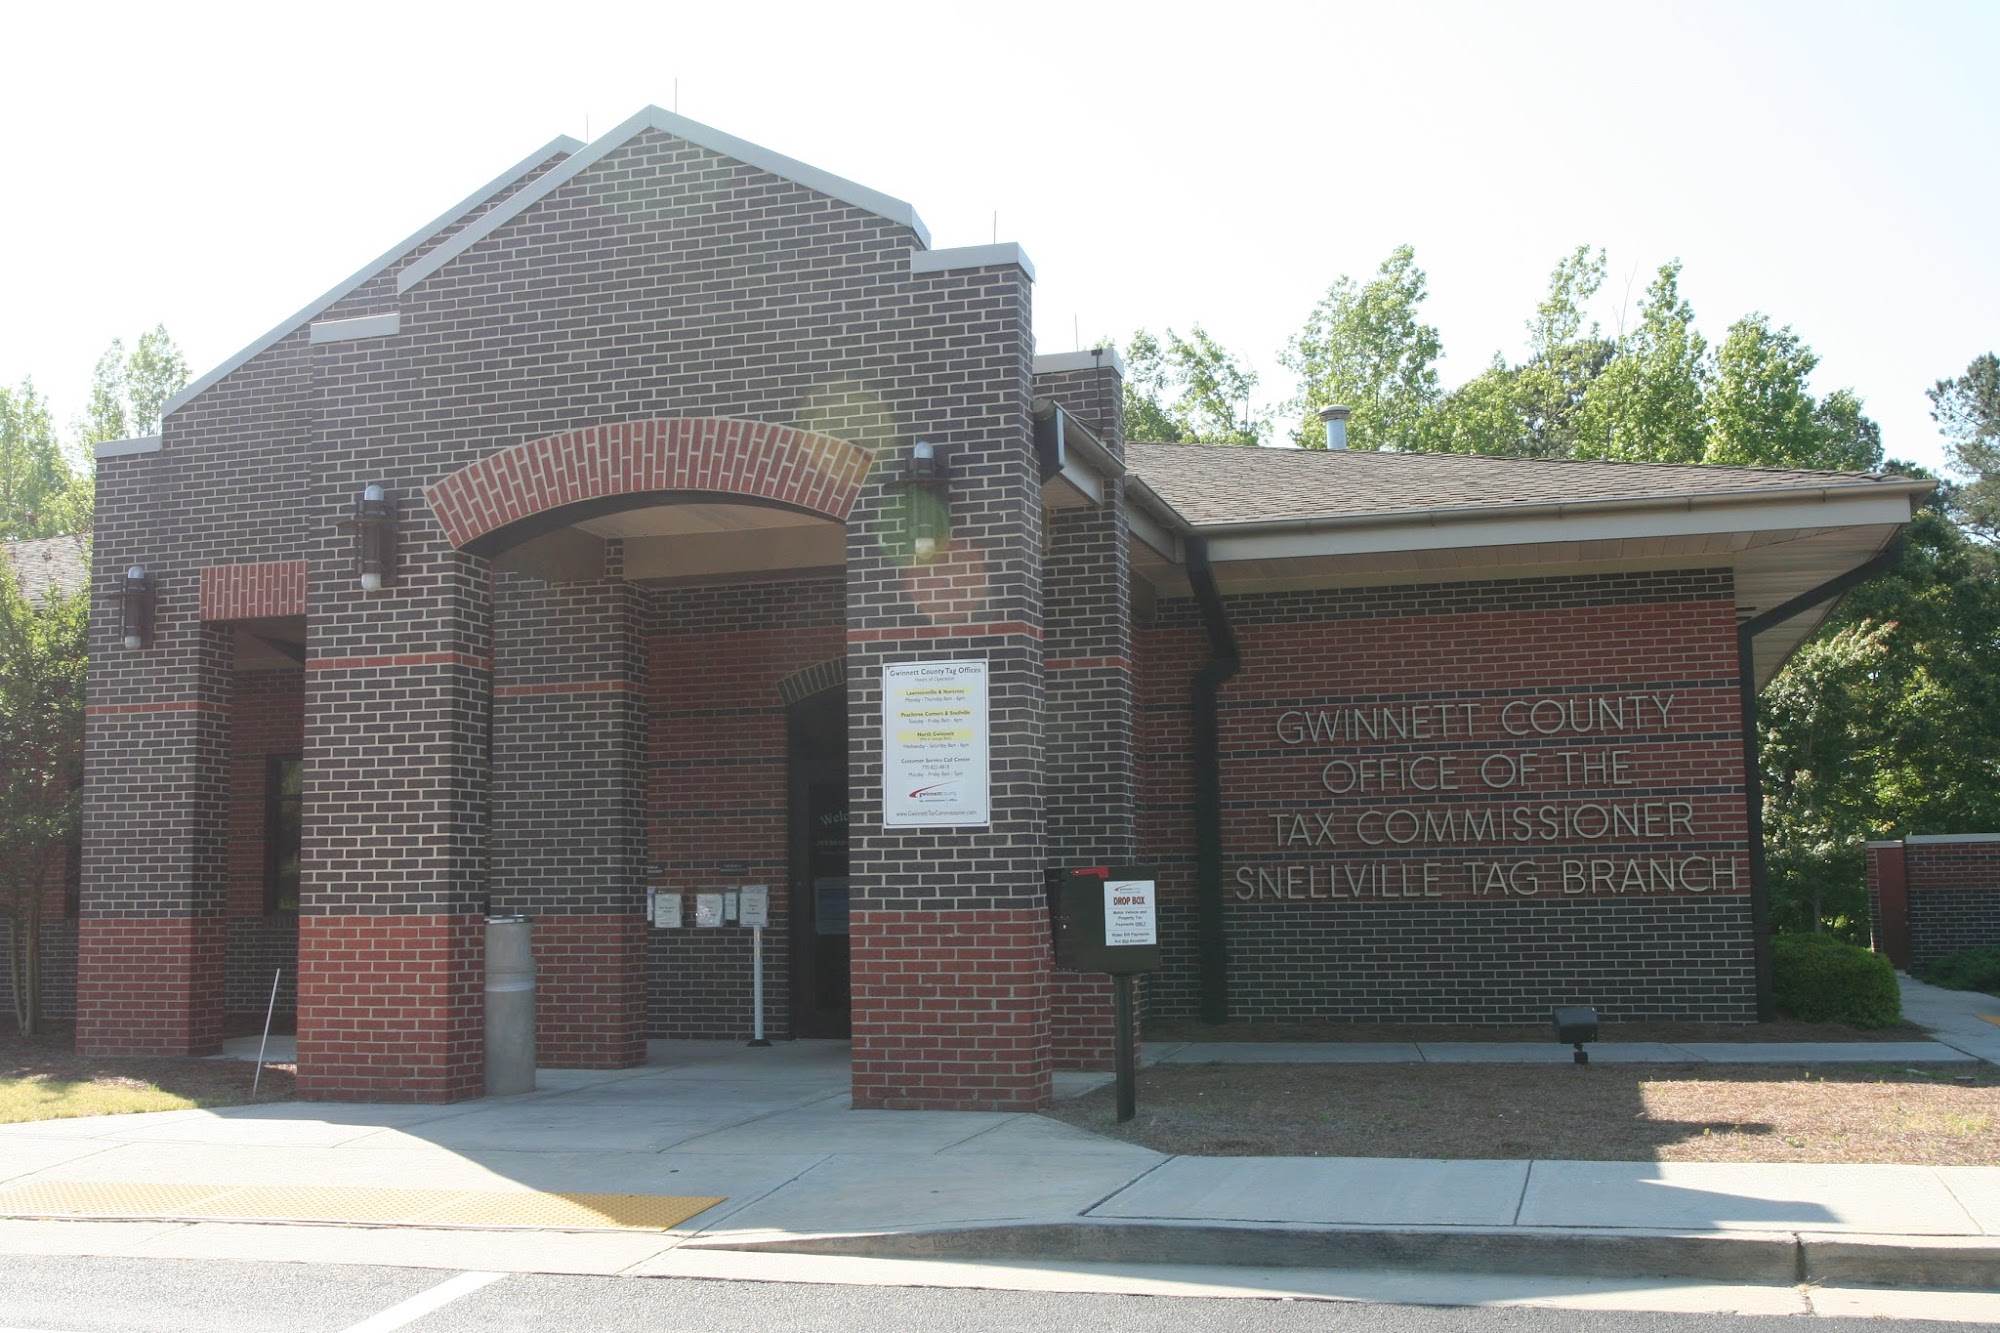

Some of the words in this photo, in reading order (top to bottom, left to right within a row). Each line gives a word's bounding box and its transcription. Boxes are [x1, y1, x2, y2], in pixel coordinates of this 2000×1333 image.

[921, 668, 944, 676] County
[945, 667, 957, 676] Tag
[958, 666, 981, 674] Offices
[1276, 703, 1481, 744] GWINNETT
[1501, 694, 1675, 736] COUNTY
[1321, 756, 1459, 794] OFFICE
[1481, 753, 1538, 788] OF
[1556, 750, 1632, 785] THE
[1268, 811, 1337, 847] TAX
[1356, 801, 1695, 845] COMMISSIONER
[1235, 862, 1443, 900] SNELLVILLE
[1463, 860, 1538, 896] TAG
[1562, 855, 1736, 893] BRANCH
[1113, 896, 1131, 906] DROP
[1132, 895, 1146, 905] BOX
